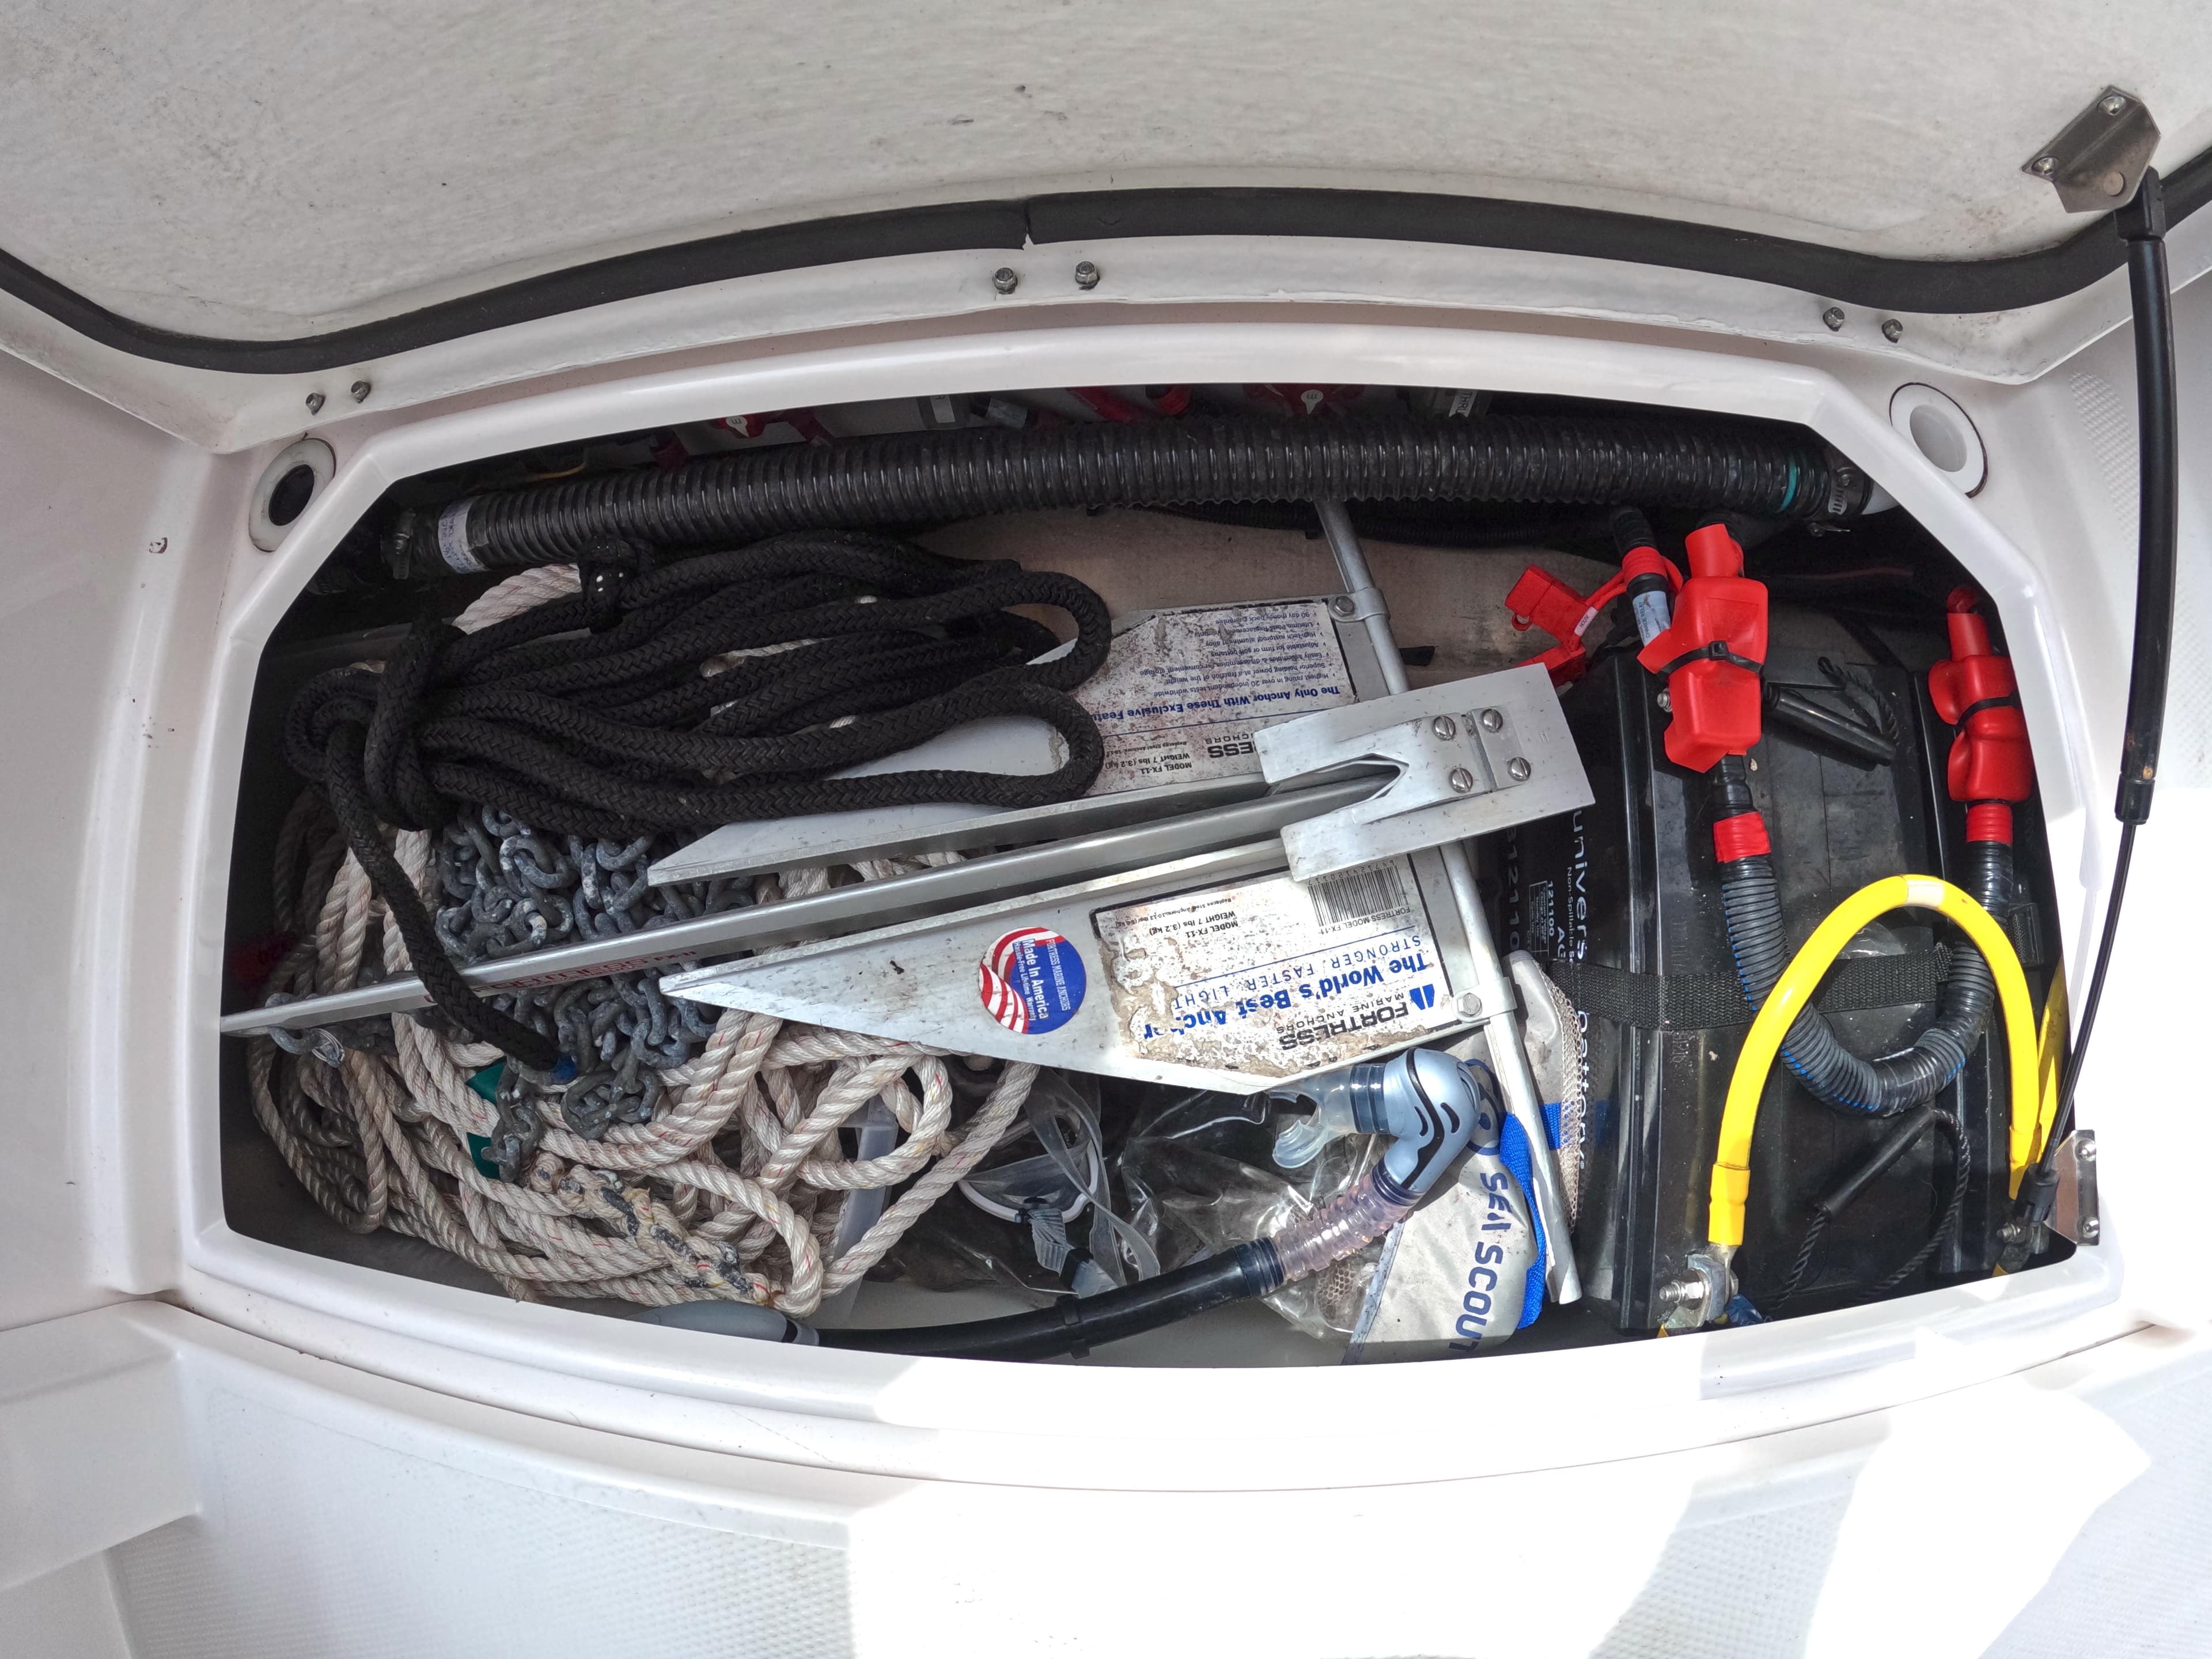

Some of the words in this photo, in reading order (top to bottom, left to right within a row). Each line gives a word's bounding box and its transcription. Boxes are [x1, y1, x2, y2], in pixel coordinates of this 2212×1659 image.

[1287, 611, 1300, 619] day
[1204, 639, 1221, 648] alloy
[1256, 633, 1286, 643] rustproof
[1286, 641, 1320, 651] Adjustable
[1304, 650, 1323, 660] Easily
[1139, 667, 1166, 677] storage
[1166, 664, 1205, 674] convenient
[1253, 666, 1273, 675] power
[1274, 664, 1298, 673] holding
[1298, 661, 1325, 671] Superior
[1164, 676, 1189, 685] weight
[1210, 671, 1238, 680] fraction
[1285, 675, 1304, 683] rating
[1304, 672, 1329, 681] Highest
[1206, 680, 1249, 691] independent
[1319, 685, 1340, 695] The
[1152, 688, 1188, 698] worldwide
[1251, 691, 1292, 703] Anchor
[1291, 686, 1319, 699] Only
[1184, 699, 1221, 711] These
[1222, 695, 1251, 707] With
[1126, 703, 1184, 718] Exclusive
[1206, 740, 1257, 758] ESS
[1119, 757, 1137, 768] (3.2
[1137, 756, 1152, 766] lbs
[1152, 756, 1158, 764] 7
[1158, 751, 1190, 763] WEIGHT
[1139, 765, 1162, 775] FX-11
[1162, 761, 1192, 771] MODEL
[1206, 897, 1231, 907] Replaces
[1205, 910, 1235, 923] WEIGHT
[1369, 906, 1411, 923] FORTRESS
[1164, 921, 1180, 933] (3.2
[1183, 919, 1195, 929] lbs
[1209, 919, 1238, 933] MODEL
[1342, 916, 1370, 930] MODEL
[1149, 925, 1162, 936] kg)
[1184, 927, 1207, 938] FX-11
[1320, 923, 1341, 936] FX-11
[1557, 925, 1566, 958] AG
[1012, 942, 1026, 973] Hassle-Free
[1021, 939, 1040, 965] Made
[1045, 939, 1060, 965] FORTRESS
[1028, 966, 1043, 977] In
[1387, 952, 1428, 979] The
[1051, 965, 1065, 986] MARINE
[1020, 973, 1031, 995] Lifetime
[1298, 964, 1385, 1005] World's
[1031, 978, 1052, 1020] America
[1056, 986, 1071, 1011] ANCHORS
[1236, 988, 1291, 1020] Best
[1351, 991, 1405, 1014] MARINE
[1024, 996, 1037, 1022] Warranty
[1275, 1008, 1345, 1035] ANCHORS
[1278, 1001, 1410, 1051] FORTRESS
[1479, 1172, 1513, 1231] SEA
[1448, 1241, 1503, 1354] SCOUT
